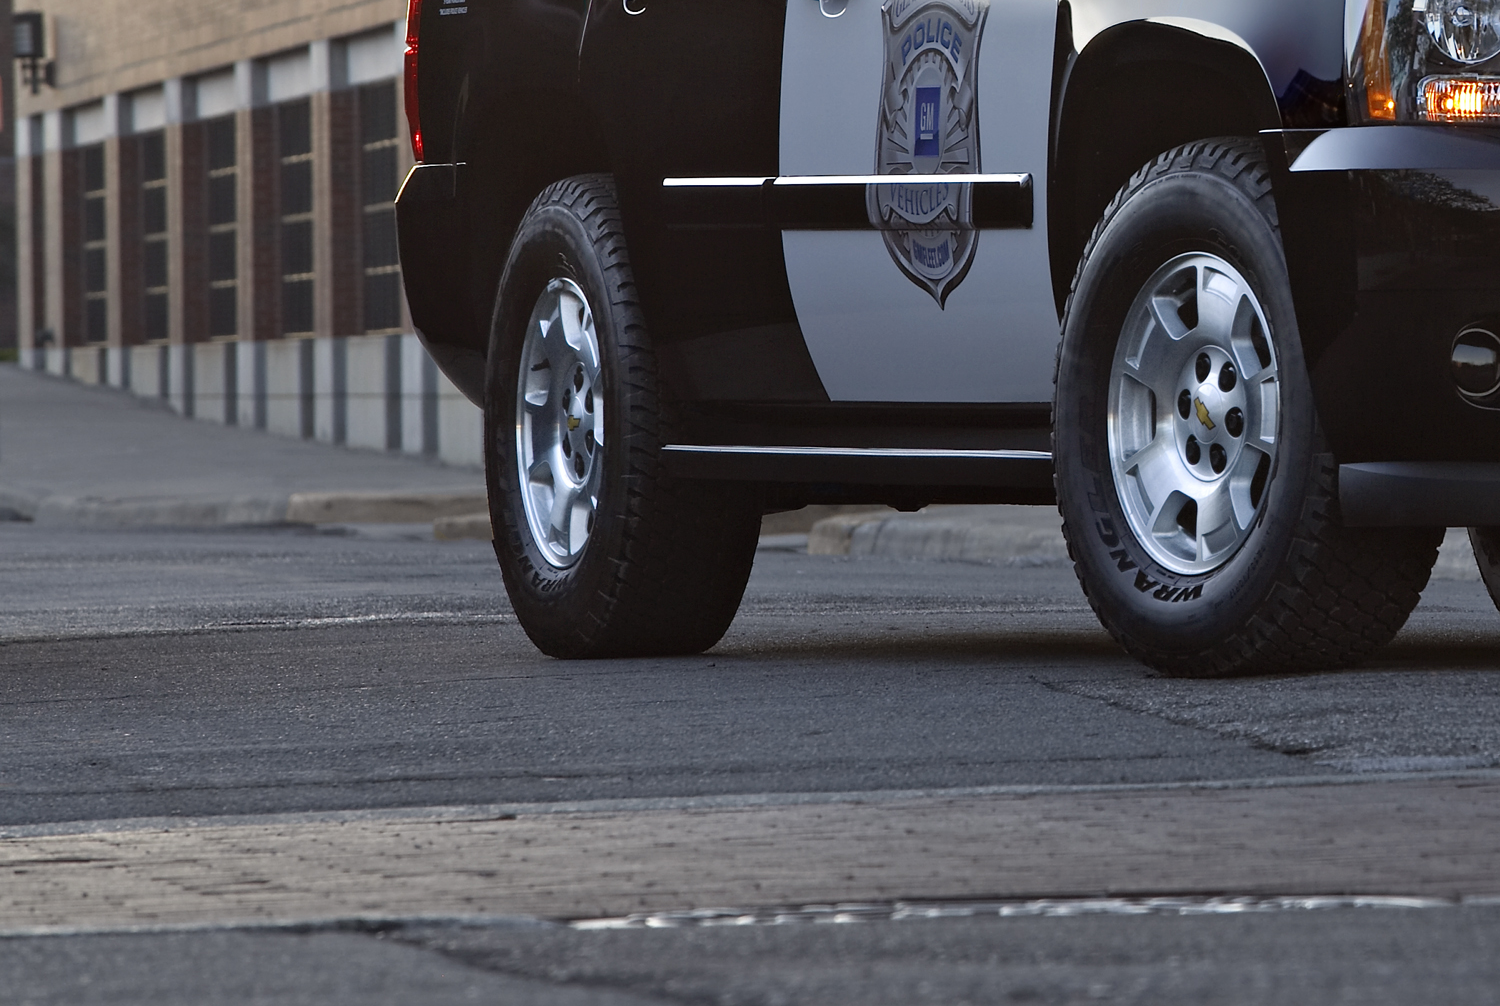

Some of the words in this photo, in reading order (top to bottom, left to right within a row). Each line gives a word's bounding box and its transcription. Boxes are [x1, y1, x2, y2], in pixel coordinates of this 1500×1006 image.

[901, 17, 963, 66] POLICE
[920, 102, 935, 131] GM
[890, 182, 950, 215] VEHICLES
